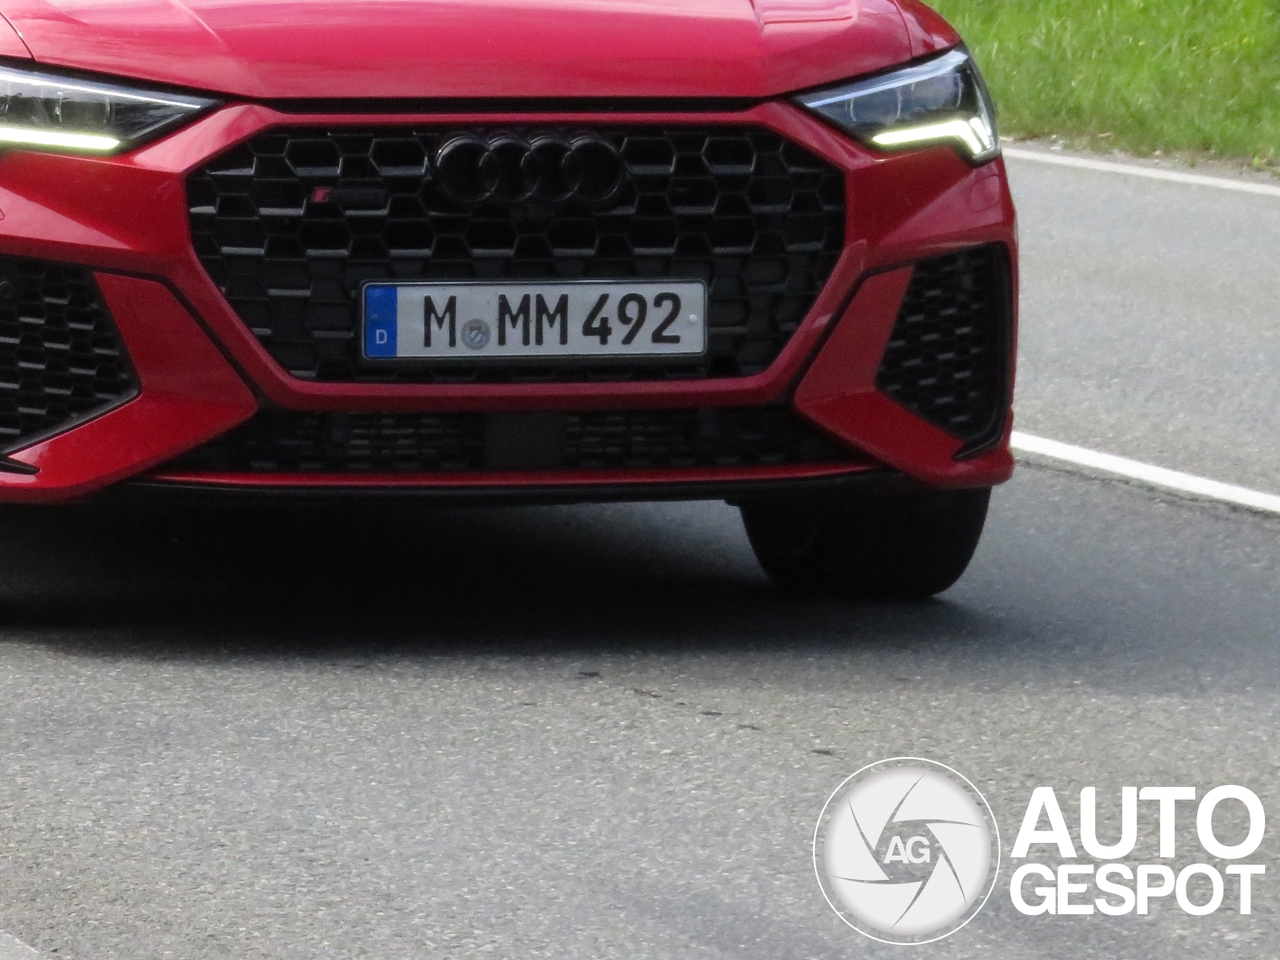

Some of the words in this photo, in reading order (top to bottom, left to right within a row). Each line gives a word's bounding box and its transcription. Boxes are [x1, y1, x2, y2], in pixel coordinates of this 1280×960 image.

[376, 330, 388, 345] D
[423, 295, 457, 348] M
[498, 293, 568, 346] MM
[581, 292, 682, 346] 492
